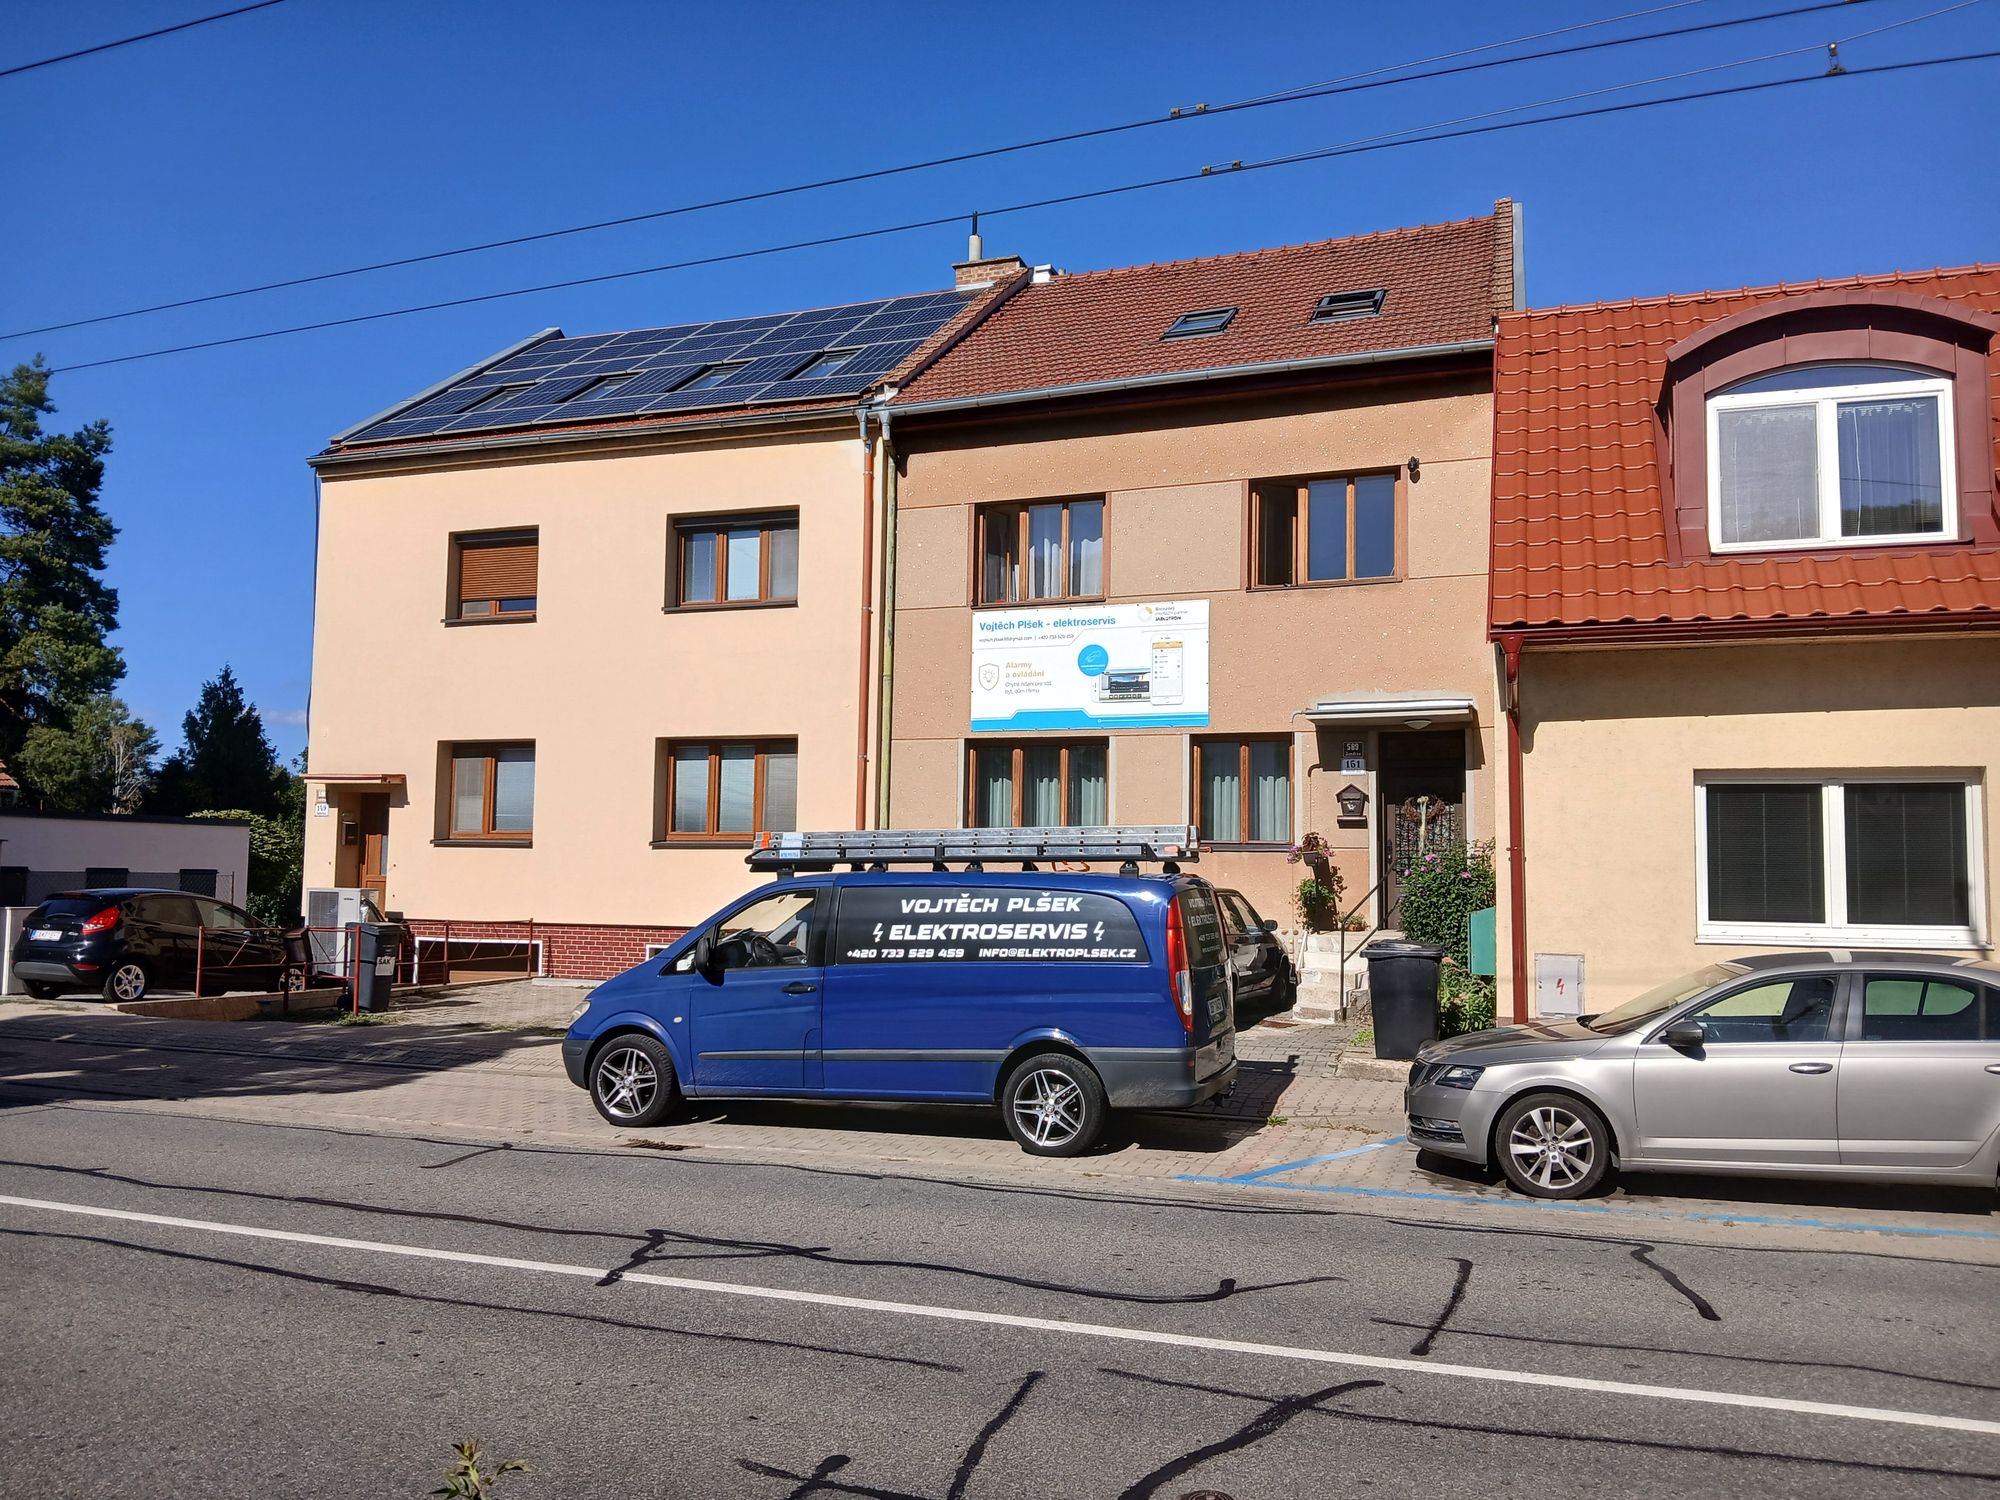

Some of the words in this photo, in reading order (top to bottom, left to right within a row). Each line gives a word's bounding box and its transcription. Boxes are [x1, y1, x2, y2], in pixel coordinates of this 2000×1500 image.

[979, 621, 1015, 633] Vojtěch
[1017, 619, 1044, 629] Plšek
[1053, 616, 1116, 628] elektroservis
[901, 893, 999, 913] VOJTĚCH
[1006, 892, 1083, 912] PLŠEK
[888, 923, 1088, 941] ELEKTROSERVIS
[847, 949, 877, 958] +420
[881, 949, 905, 958] 733
[908, 949, 934, 958] 529
[938, 948, 964, 957] 459
[978, 948, 1137, 958] INFO@ELEKTROPLSEK.CZ
